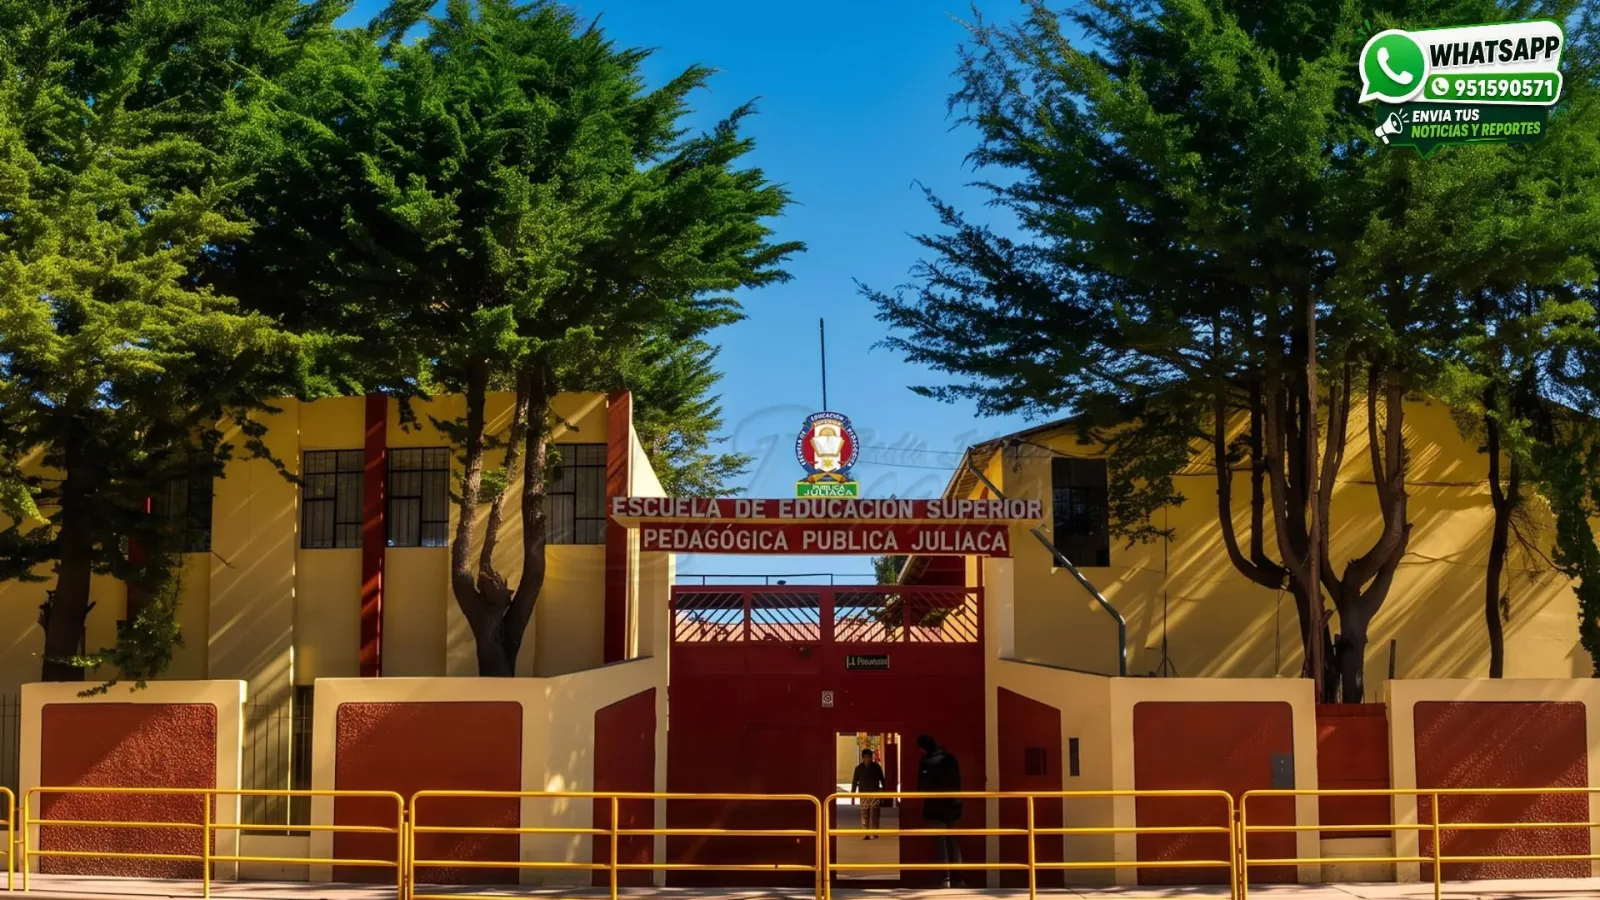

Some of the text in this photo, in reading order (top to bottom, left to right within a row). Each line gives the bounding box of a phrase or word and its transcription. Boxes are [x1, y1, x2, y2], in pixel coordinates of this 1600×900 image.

[612, 497, 721, 518] ESCUELA
[735, 500, 766, 518] DE
[927, 499, 1041, 519] SUPERIOR
[644, 524, 1007, 551] PEDAGÓGICA PUBLICA JULIACA
